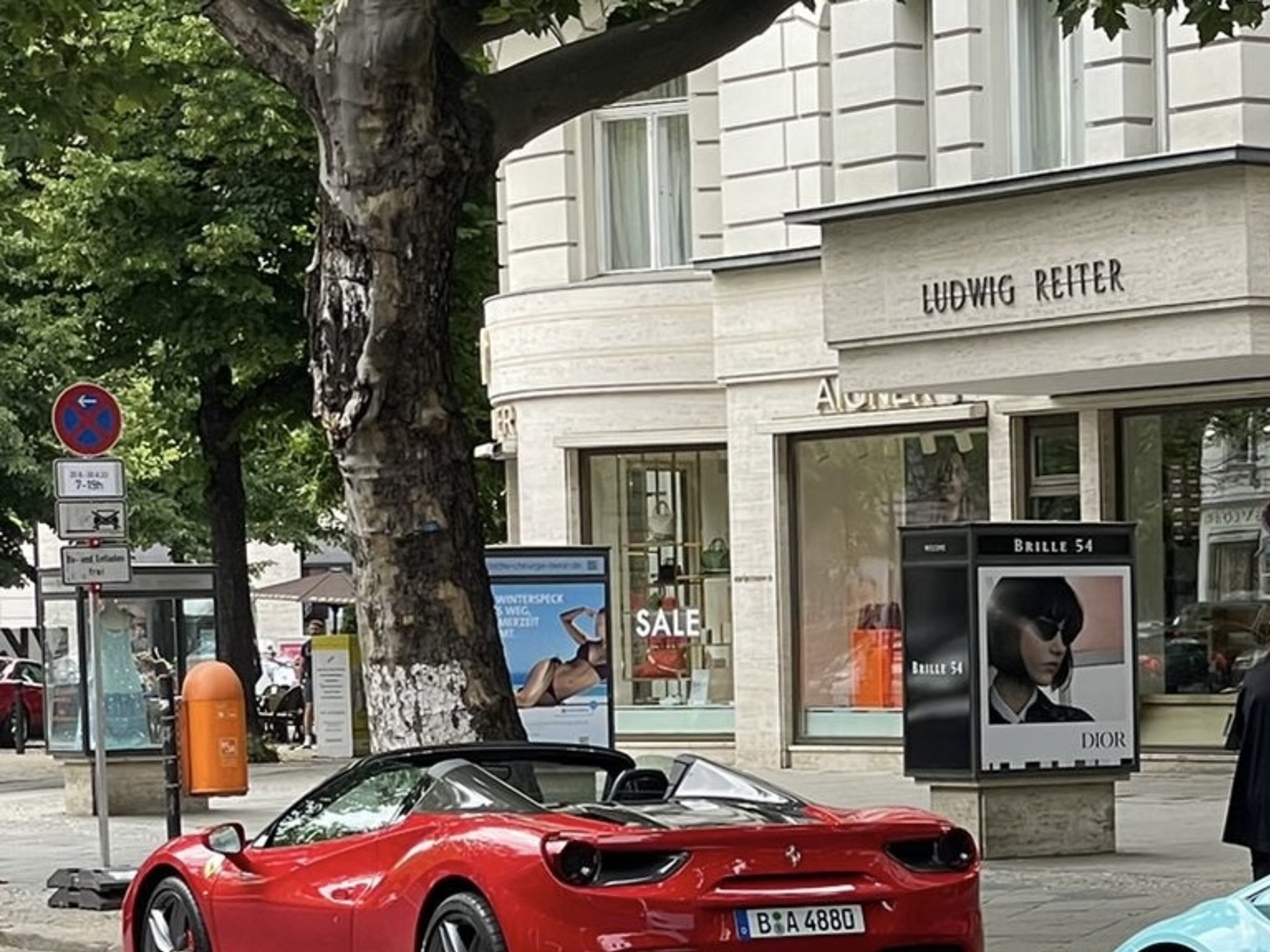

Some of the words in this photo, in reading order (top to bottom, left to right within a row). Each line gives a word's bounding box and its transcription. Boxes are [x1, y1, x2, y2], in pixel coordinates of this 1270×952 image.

[922, 273, 1016, 315] LUDWIG
[1034, 257, 1125, 303] REITER
[1075, 538, 1094, 553] 54
[494, 593, 566, 605] WINTERSPECK
[635, 608, 700, 637] SALE
[951, 661, 963, 675] 54
[1081, 731, 1126, 750] DIOR
[757, 912, 772, 935] B
[786, 911, 800, 932] A
